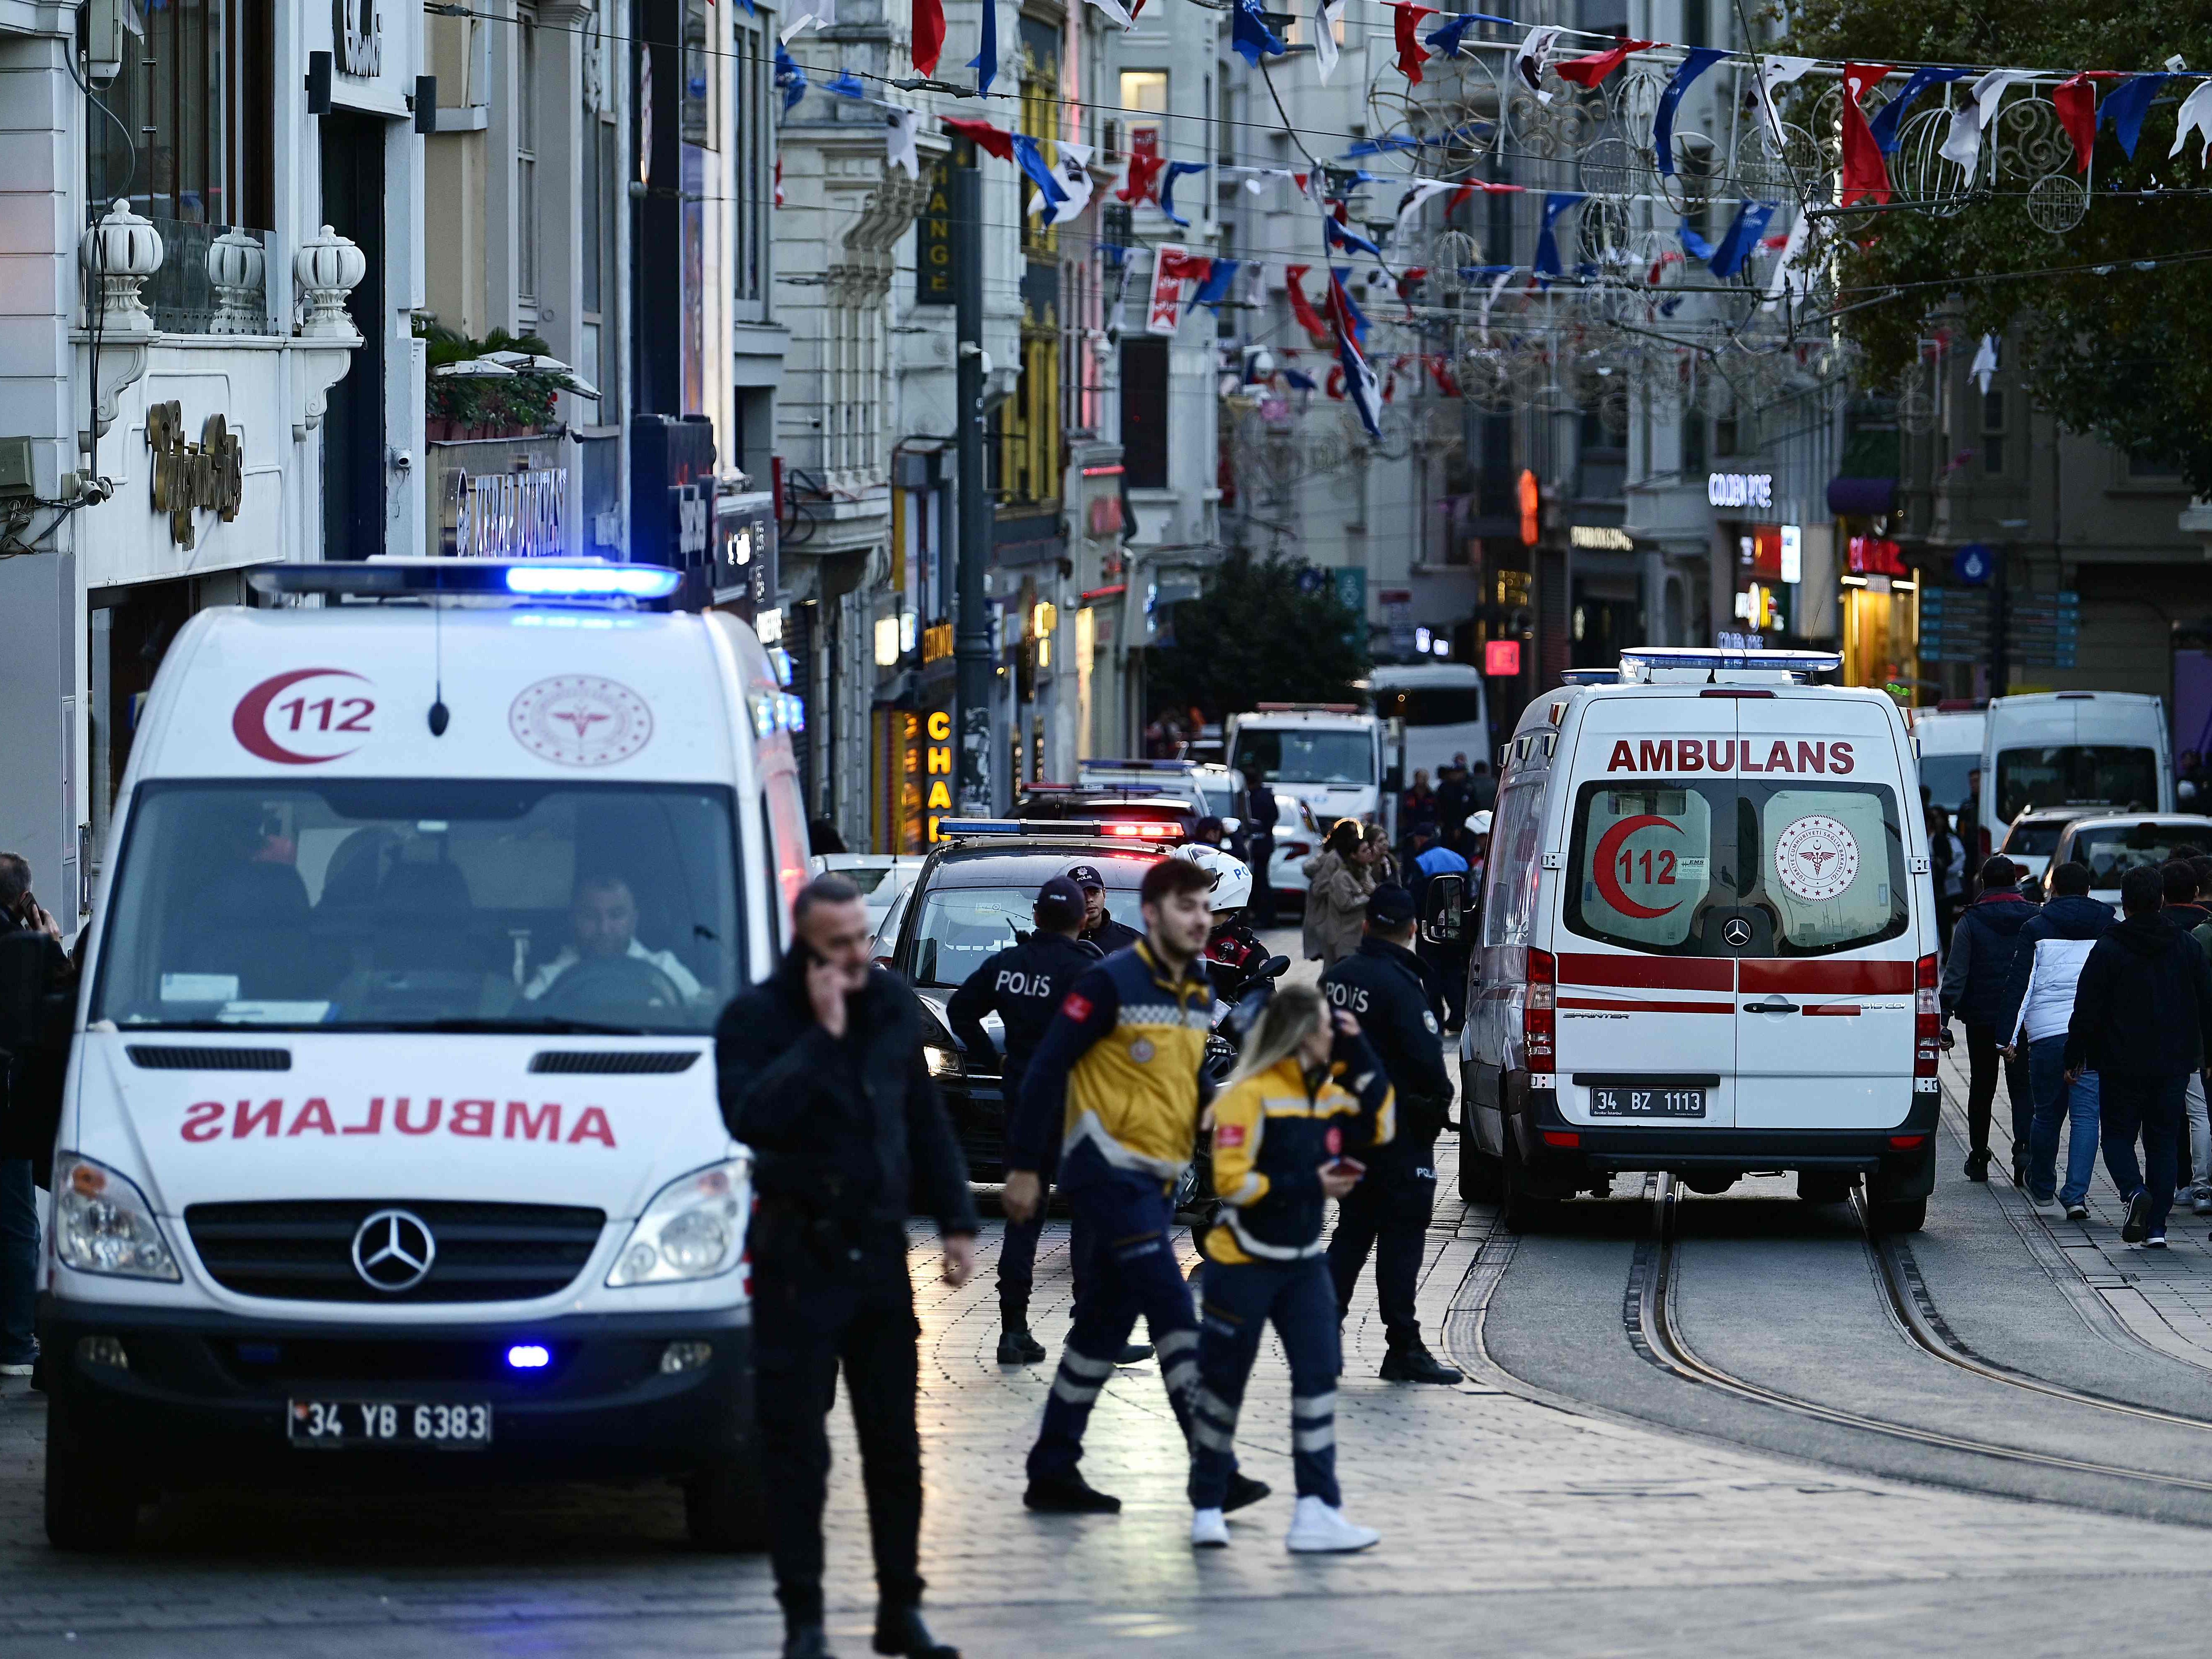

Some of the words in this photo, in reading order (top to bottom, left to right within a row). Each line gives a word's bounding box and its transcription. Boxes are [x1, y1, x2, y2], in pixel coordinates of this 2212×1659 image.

[279, 697, 374, 731] 112
[1607, 740, 1854, 774] AMBULANS
[1823, 832, 1841, 848] SAĞLIK
[1619, 849, 1676, 884] 112
[1830, 849, 1844, 880] BAKANLIĞI
[1597, 1092, 1617, 1109] 34
[1632, 1093, 1651, 1110] BZ
[1664, 1093, 1700, 1110] 1113
[307, 1402, 342, 1437] 34
[361, 1404, 396, 1438] YB
[414, 1404, 486, 1439] 6383
